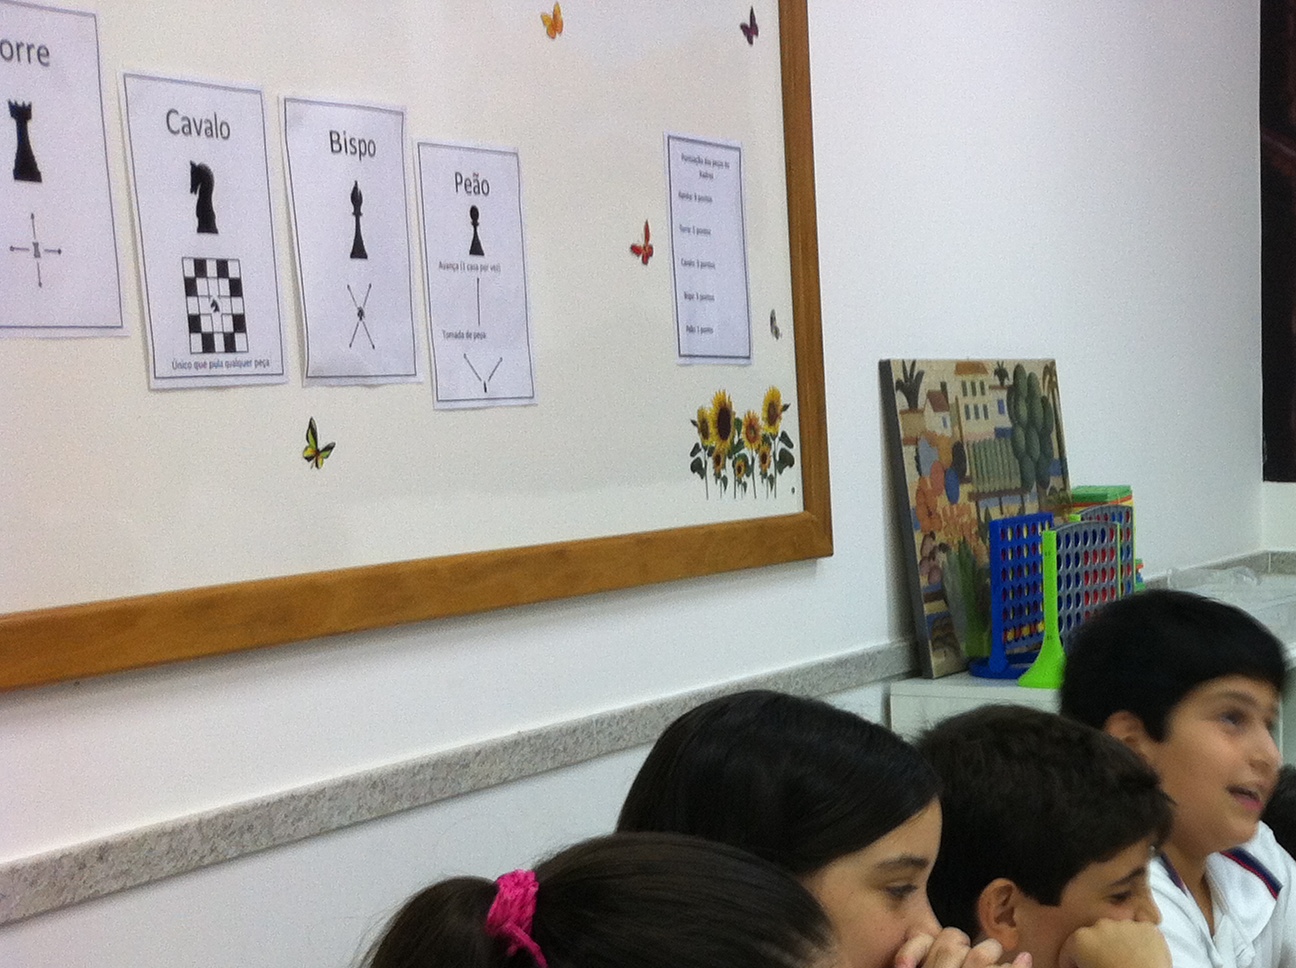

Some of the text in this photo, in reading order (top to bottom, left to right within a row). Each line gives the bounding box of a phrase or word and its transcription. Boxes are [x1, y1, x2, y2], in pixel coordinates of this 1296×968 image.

[0, 38, 51, 67] orre
[166, 107, 231, 140] Cavalo
[329, 129, 377, 161] Bispo
[454, 171, 490, 196] Peão
